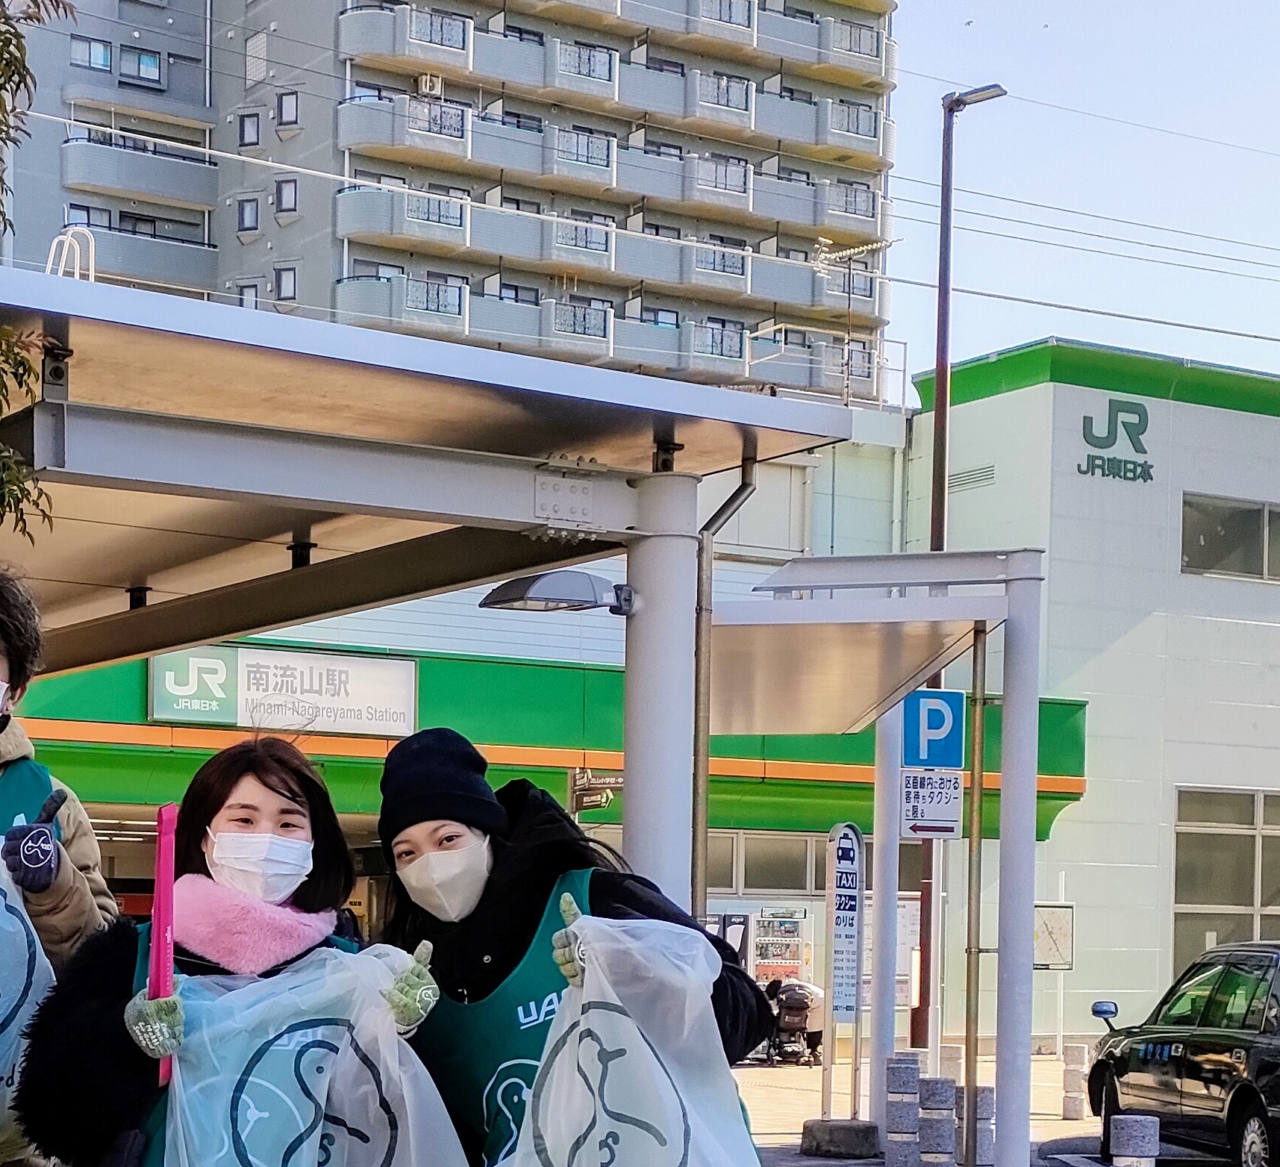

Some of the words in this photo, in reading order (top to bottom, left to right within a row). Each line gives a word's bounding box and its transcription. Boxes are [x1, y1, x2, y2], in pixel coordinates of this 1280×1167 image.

[1083, 398, 1149, 454] JR
[1077, 454, 1154, 482] JR東日本
[165, 657, 227, 698] JR
[245, 662, 350, 698] 南流山駅
[173, 698, 219, 711] JR東日本
[245, 697, 363, 722] Minami-Nagareyama
[366, 706, 406, 723] Station
[919, 698, 953, 760] P
[904, 790, 959, 804] 客待ちタクシー
[905, 804, 926, 819] に限る
[836, 873, 856, 888] TAXI
[835, 895, 856, 910] タクシー
[835, 915, 855, 928] のりば
